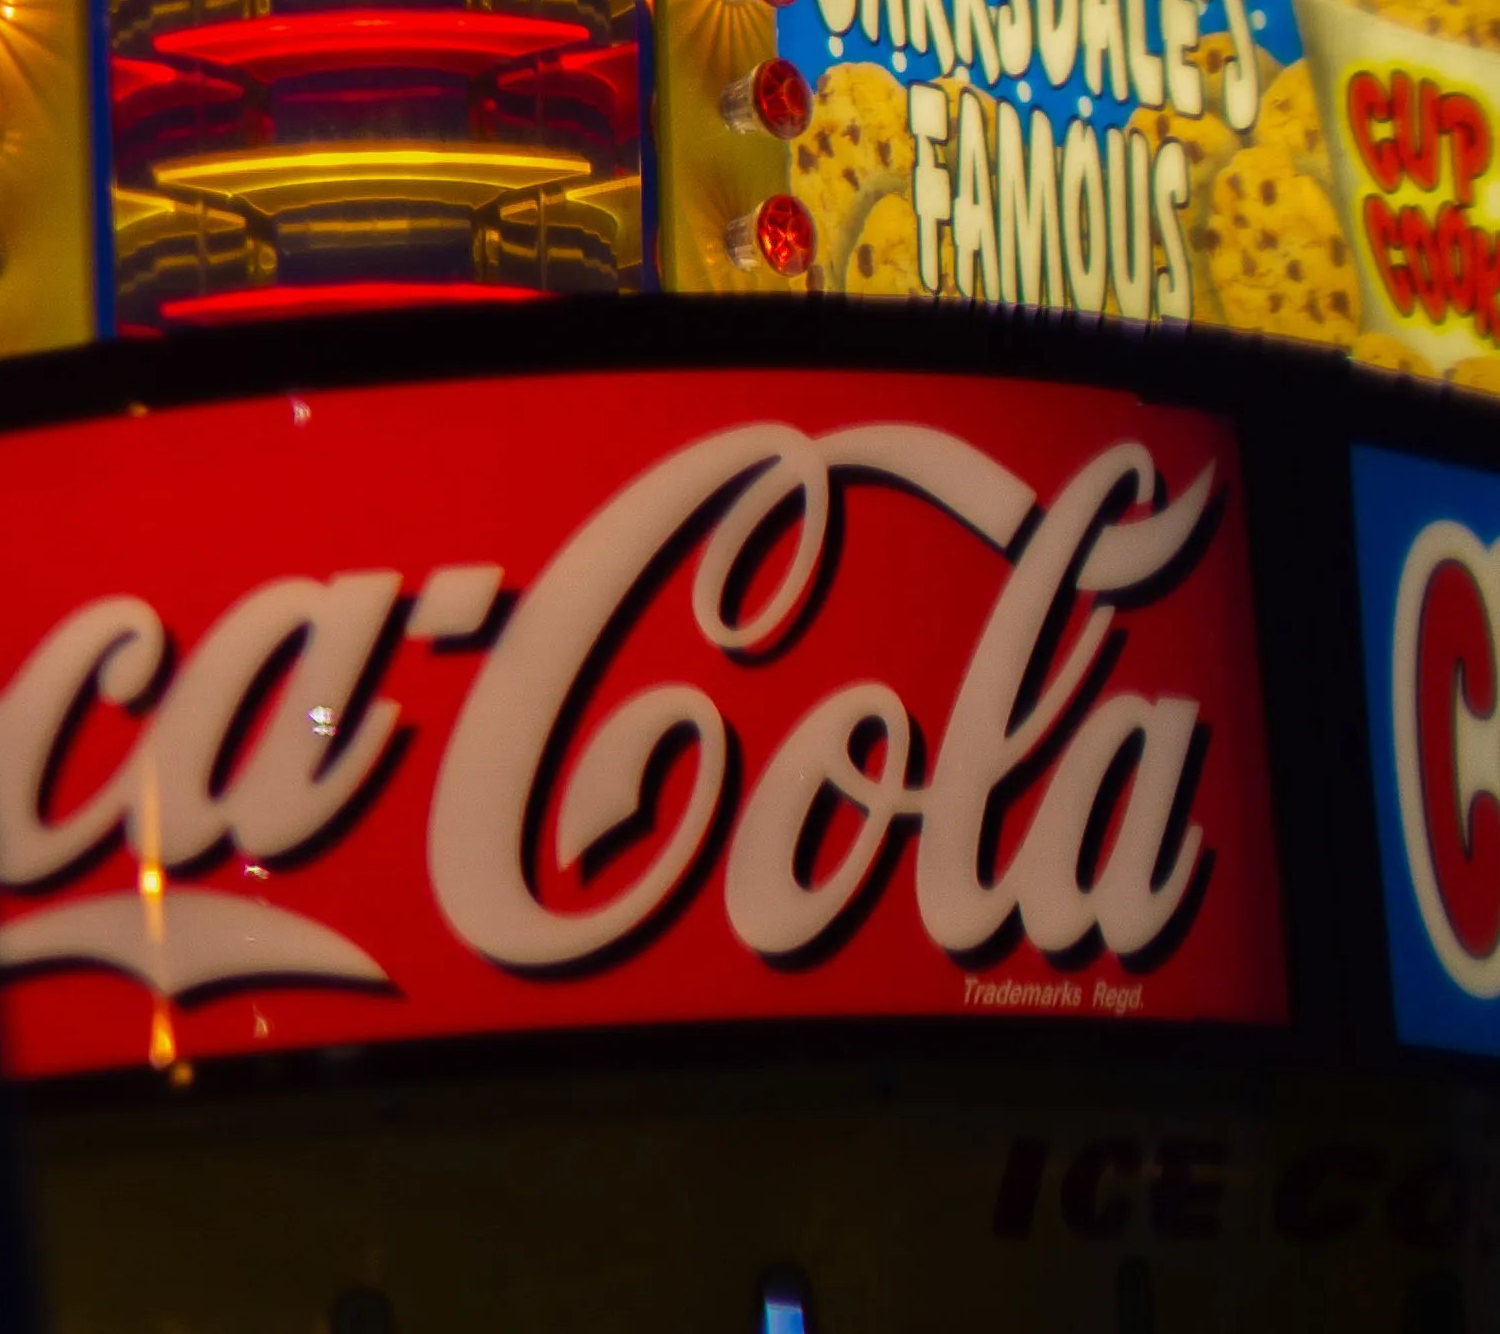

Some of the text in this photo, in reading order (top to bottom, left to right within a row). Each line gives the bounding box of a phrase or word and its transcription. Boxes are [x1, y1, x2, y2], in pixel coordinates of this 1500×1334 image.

[1346, 69, 1494, 208] CUP
[909, 81, 1195, 324] FAMOUS
[963, 973, 1083, 1008] Trademarks
[993, 1137, 1228, 1242] ICE
